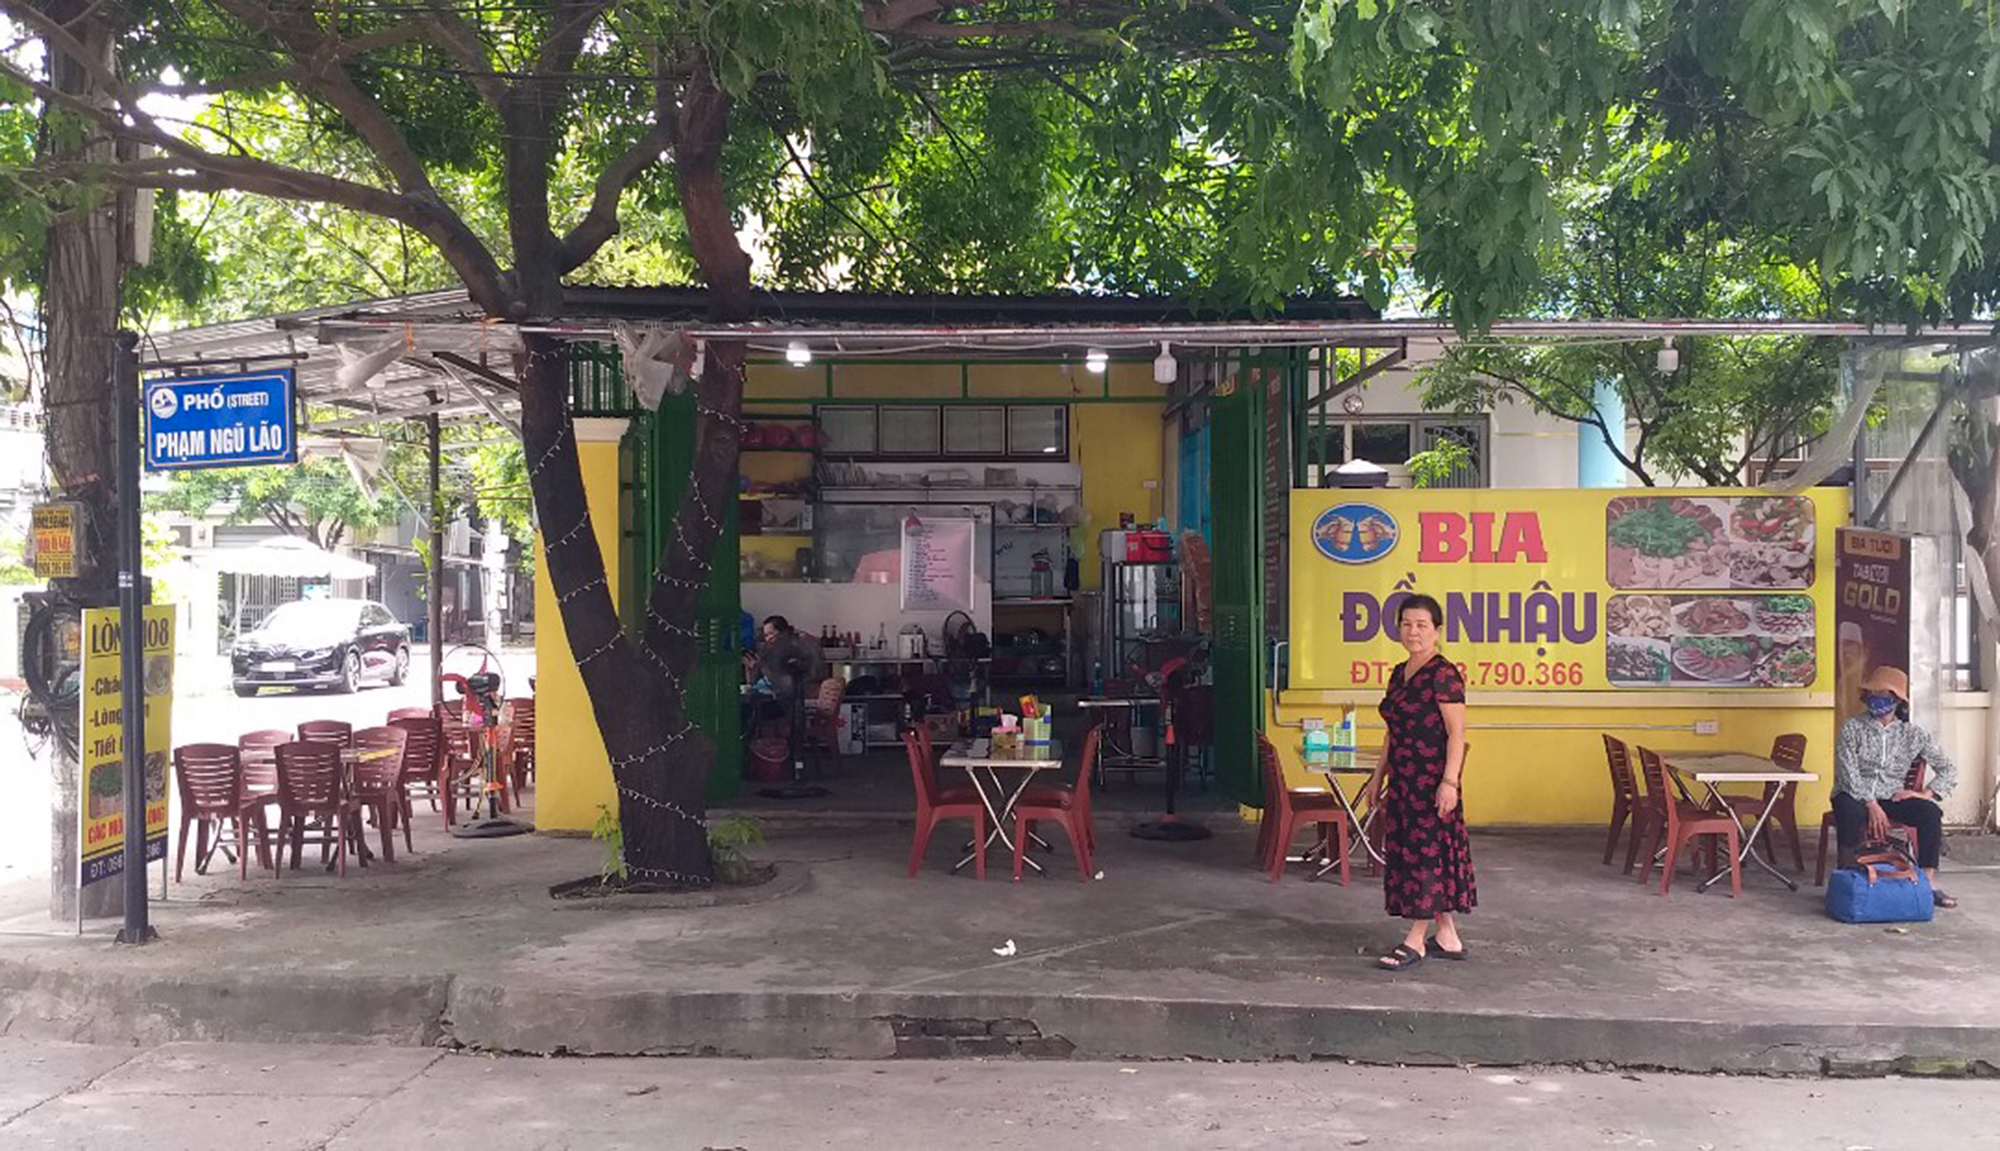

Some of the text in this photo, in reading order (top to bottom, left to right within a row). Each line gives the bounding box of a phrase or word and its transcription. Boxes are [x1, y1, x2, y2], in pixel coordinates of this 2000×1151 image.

[183, 385, 269, 411] PHỐ (STREET)
[156, 420, 282, 461] PHẠM NGŨ LÃO
[1418, 512, 1548, 563] BIA
[1340, 572, 1597, 657] ĐỒ NHẬU
[1844, 581, 1900, 615] GOLD
[92, 617, 121, 653] LÒN
